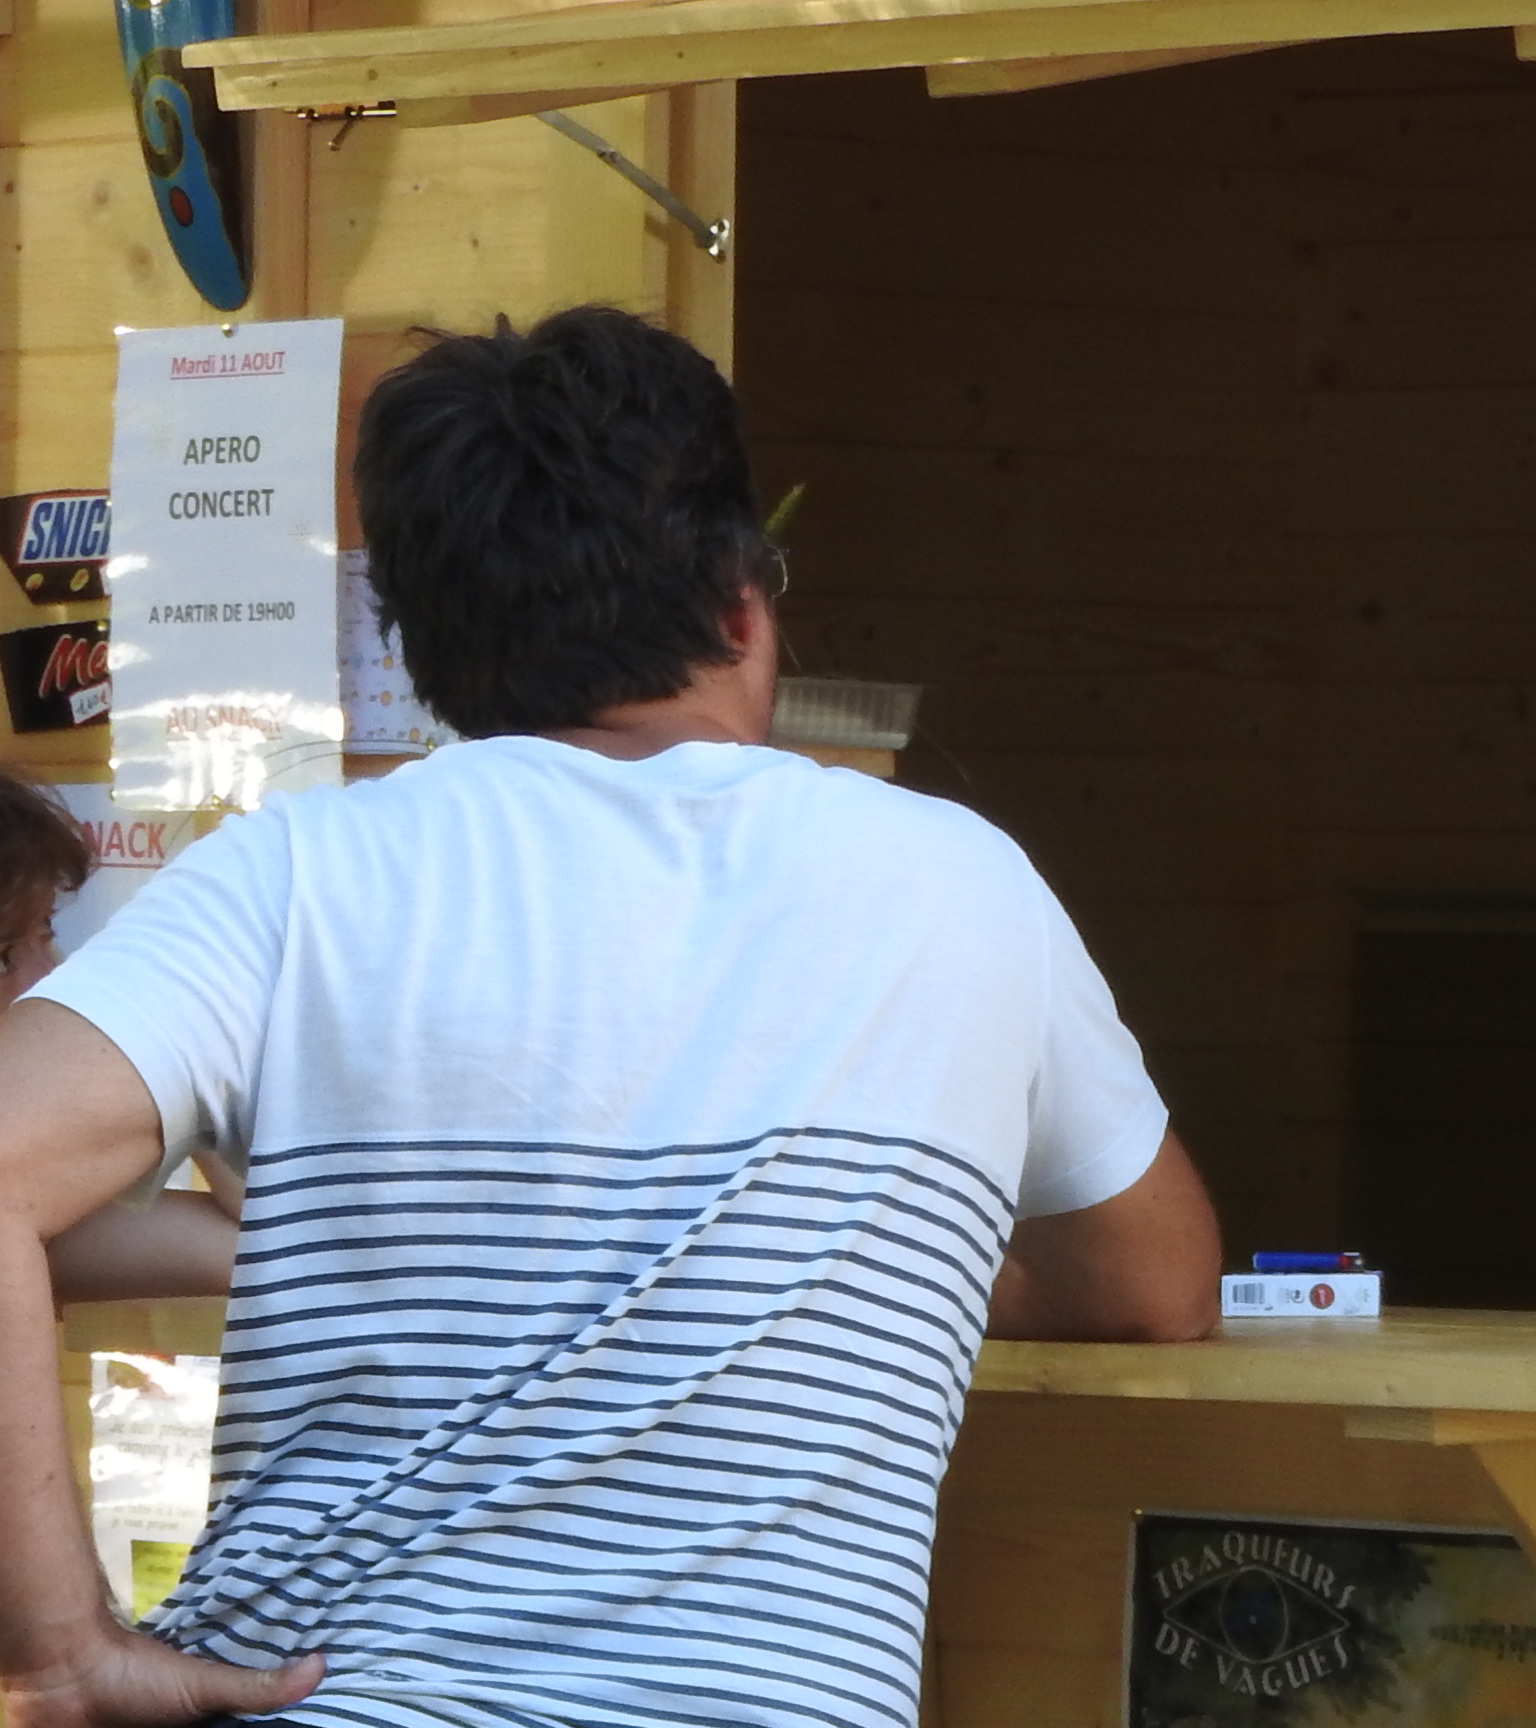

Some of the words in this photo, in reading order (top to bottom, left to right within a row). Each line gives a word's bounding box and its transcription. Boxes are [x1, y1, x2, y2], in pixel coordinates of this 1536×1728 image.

[171, 355, 216, 375] Mardi
[219, 355, 236, 373] 11
[240, 351, 286, 371] AOUT
[183, 435, 261, 466] APERO
[168, 488, 275, 520] CONCERT
[23, 499, 111, 561] SNIC
[149, 605, 161, 624] A
[164, 604, 219, 624] PARTIR
[222, 603, 243, 622] DE
[247, 601, 296, 621] 19H00
[1153, 1529, 1357, 1609] TRAQUEURS
[1154, 1622, 1200, 1671] DE
[1216, 1634, 1348, 1697] VAGUES
